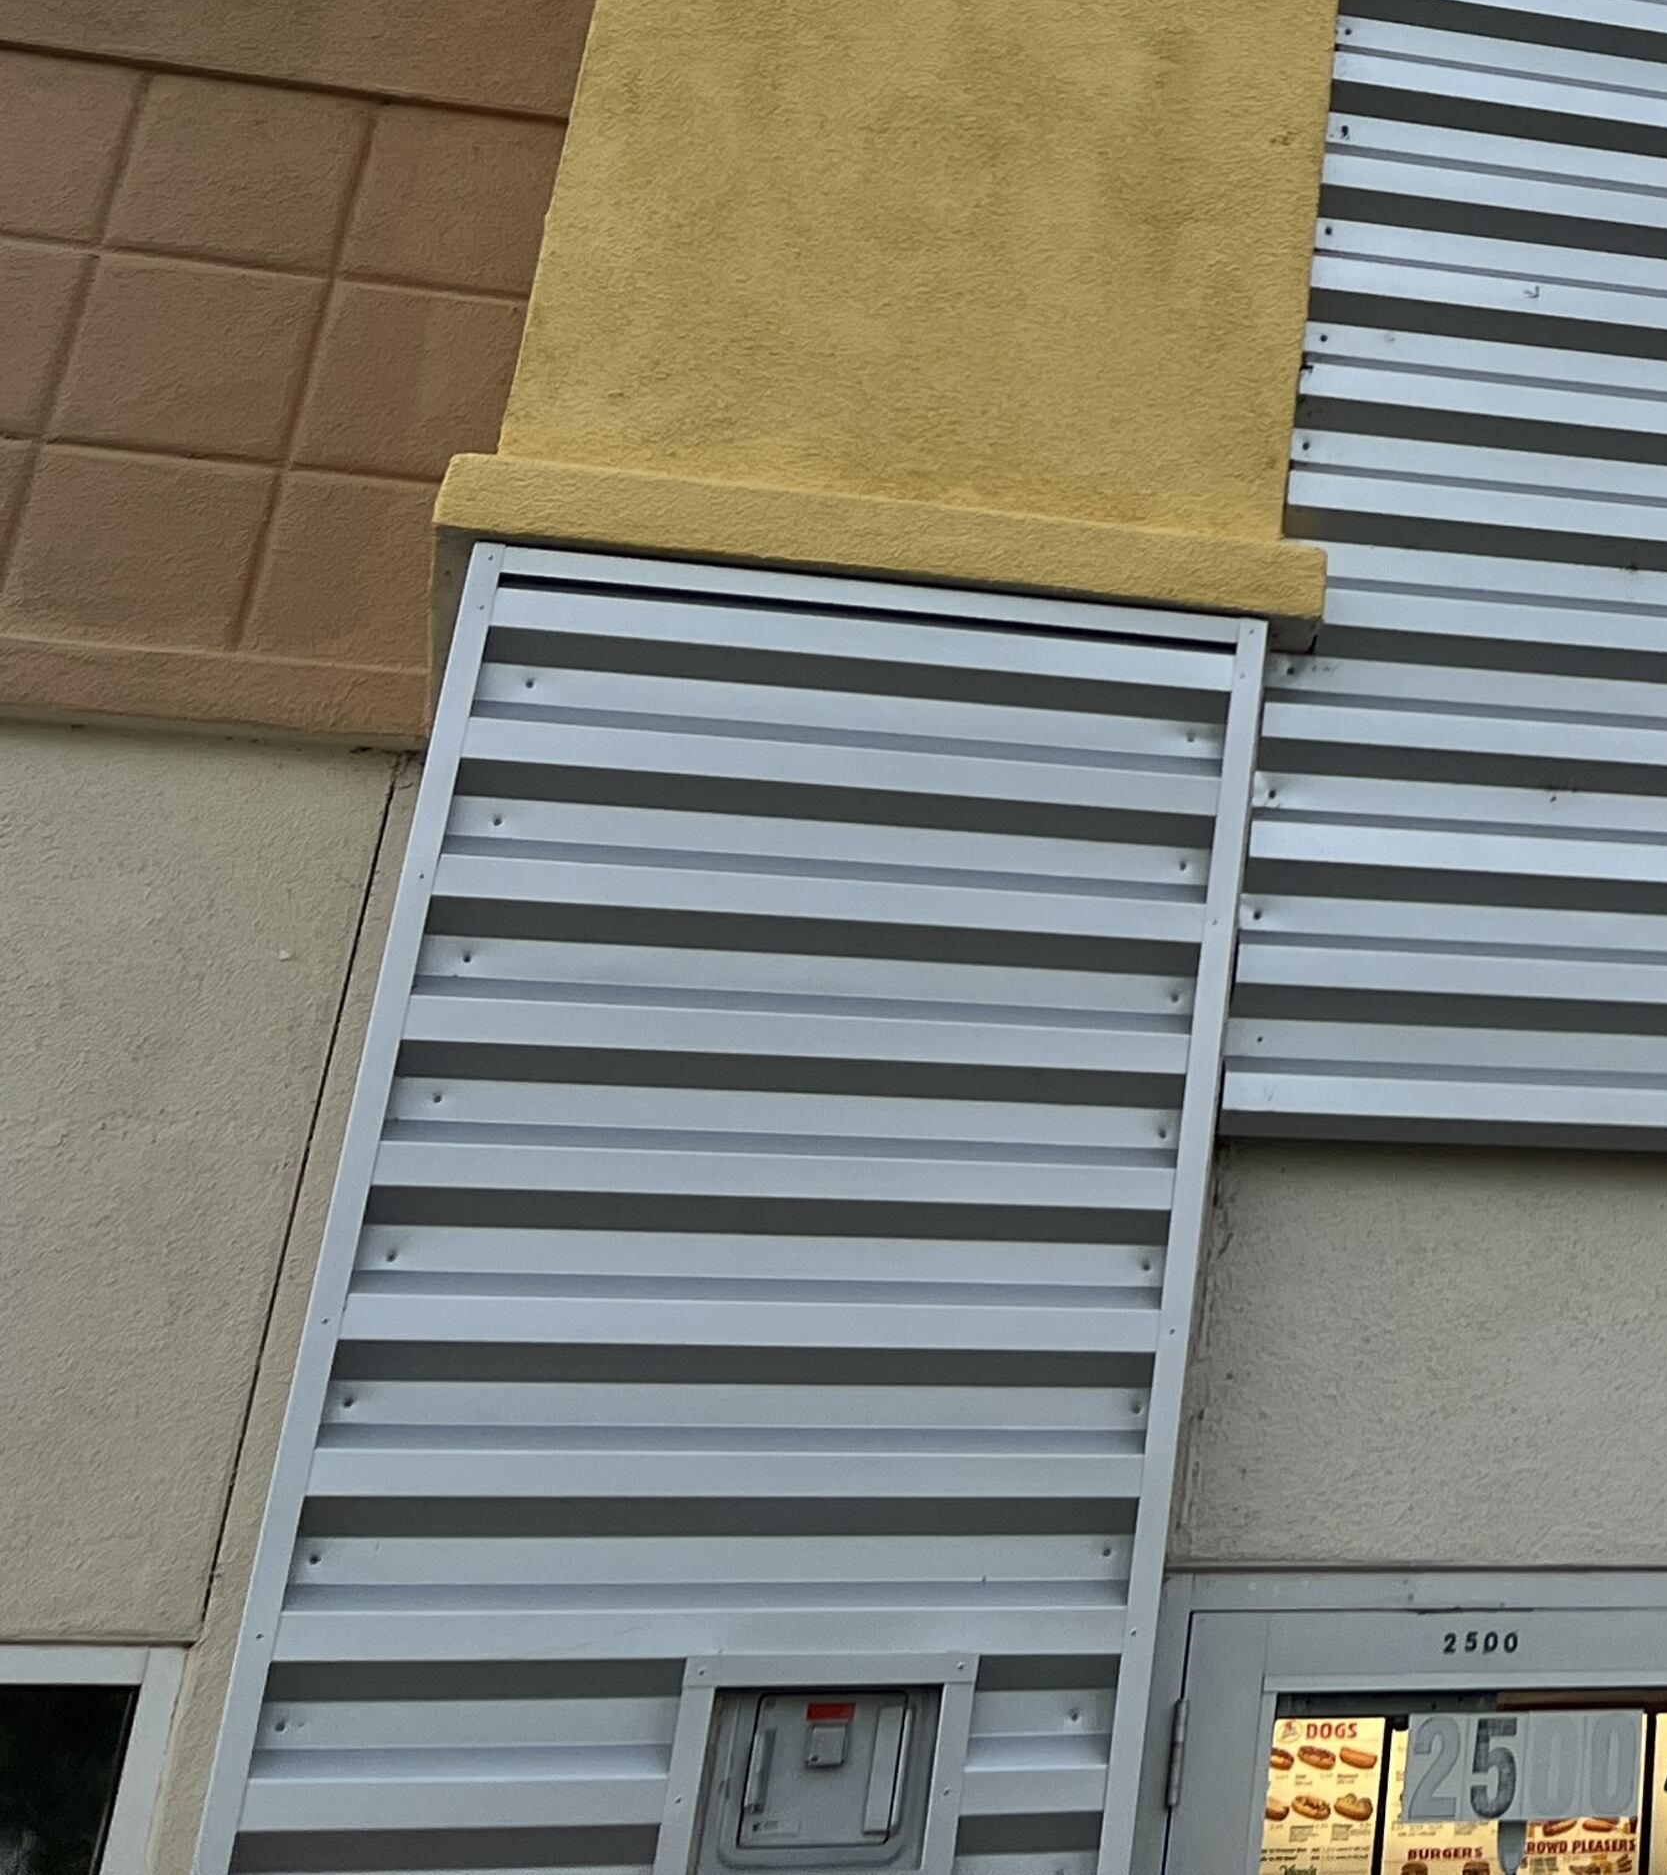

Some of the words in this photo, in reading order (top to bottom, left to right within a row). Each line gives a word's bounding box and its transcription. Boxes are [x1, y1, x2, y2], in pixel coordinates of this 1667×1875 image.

[1443, 1631, 1518, 1654] 2500
[1306, 1722, 1358, 1739] DOGS
[1408, 1715, 1638, 1821] 2500
[1408, 1846, 1483, 1861] BURGERS
[1526, 1841, 1568, 1854] ROWD
[1572, 1838, 1636, 1853] PLEASERS
